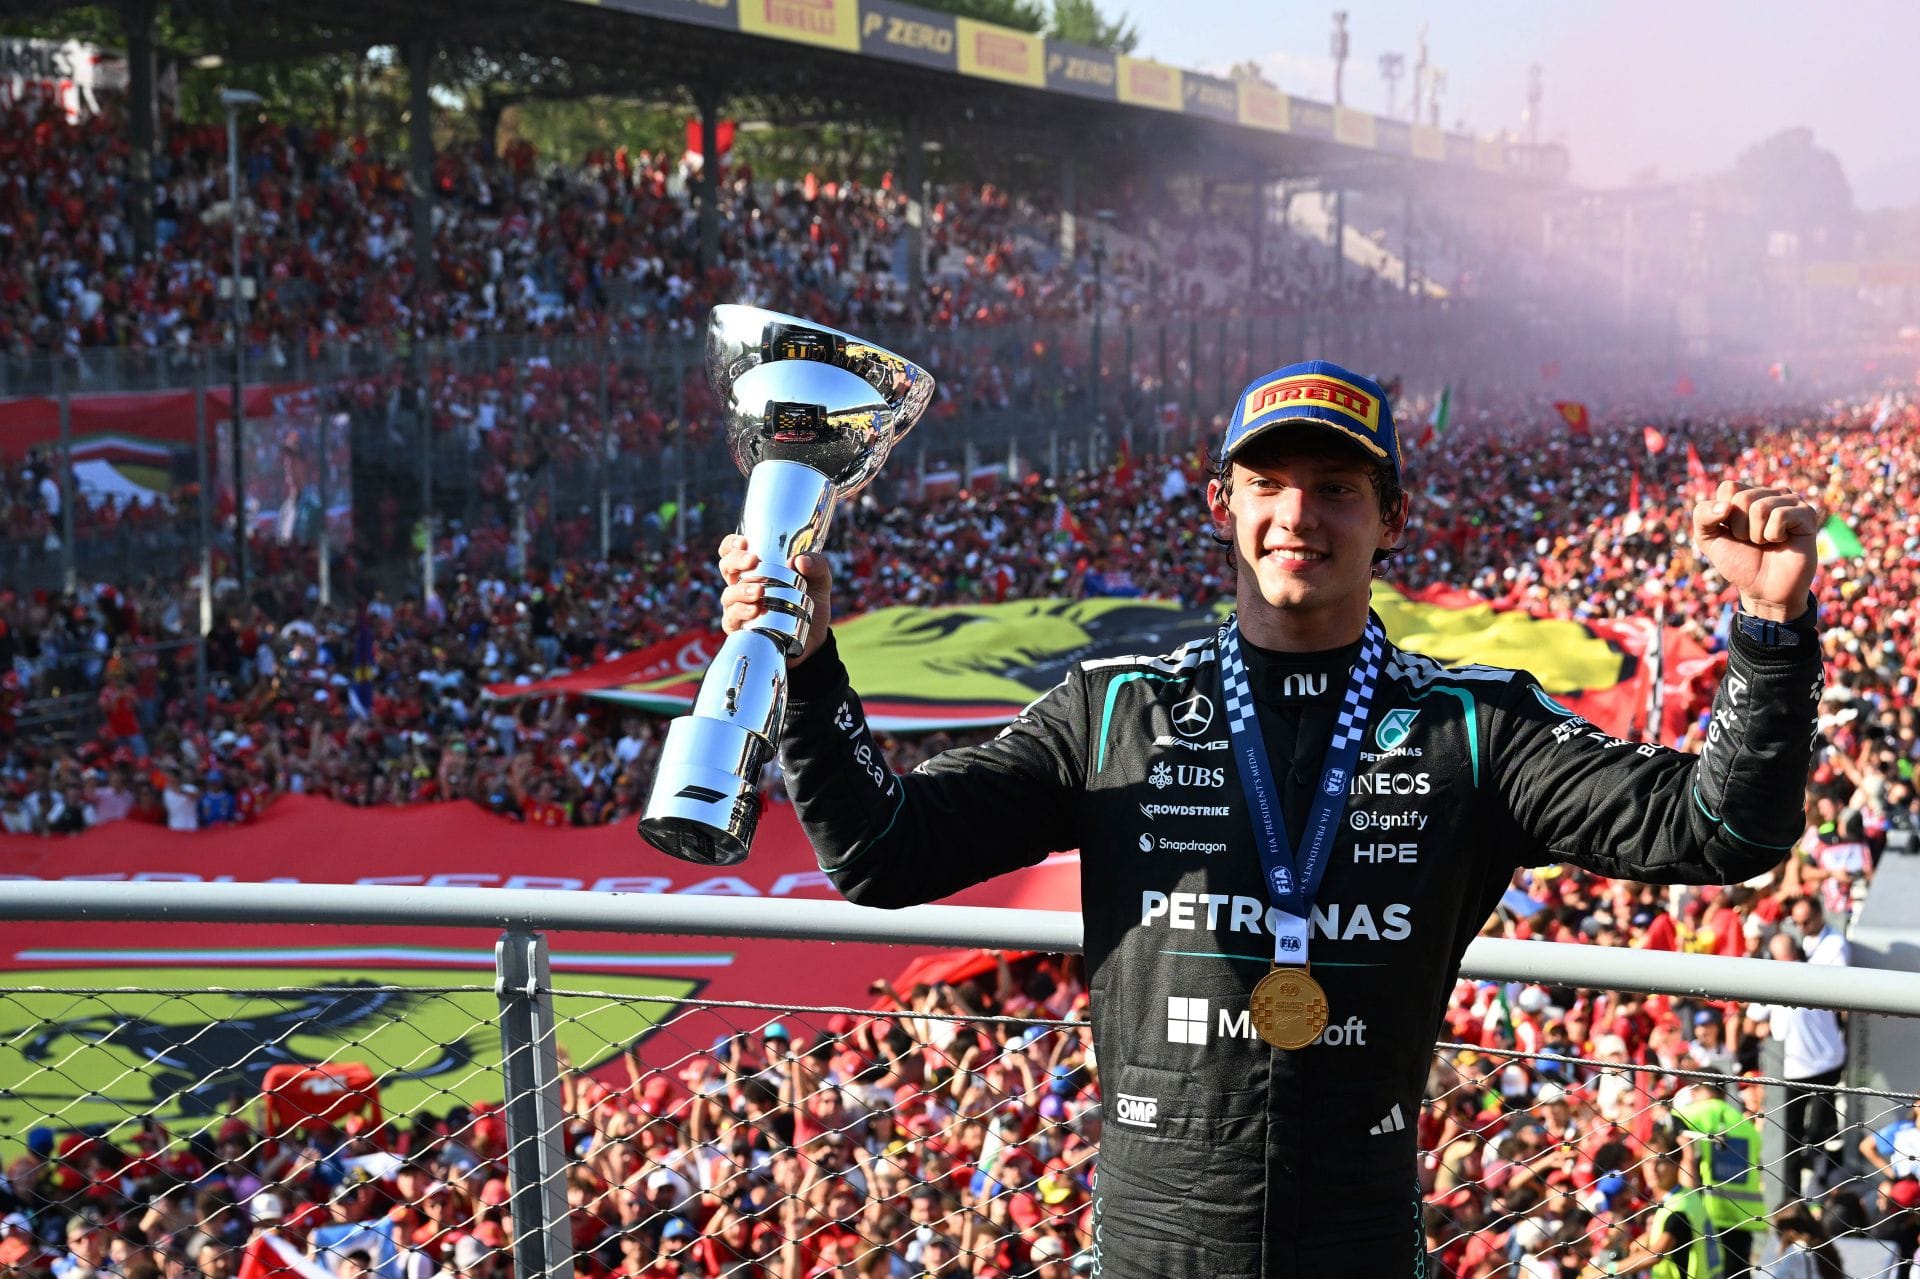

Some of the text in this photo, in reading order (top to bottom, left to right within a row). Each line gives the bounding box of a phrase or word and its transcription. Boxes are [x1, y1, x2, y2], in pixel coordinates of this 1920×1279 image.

[863, 12, 953, 54] P ZERO
[1252, 379, 1371, 418] PIRELLI
[1174, 739, 1229, 751] AMG
[1177, 765, 1225, 788] UBS
[1349, 773, 1431, 795] INEOS
[1146, 804, 1230, 817] CROWDSTRIKE
[1159, 838, 1227, 855] Snapdragon
[1354, 843, 1418, 864] HPE
[1117, 1100, 1157, 1122] OMP
